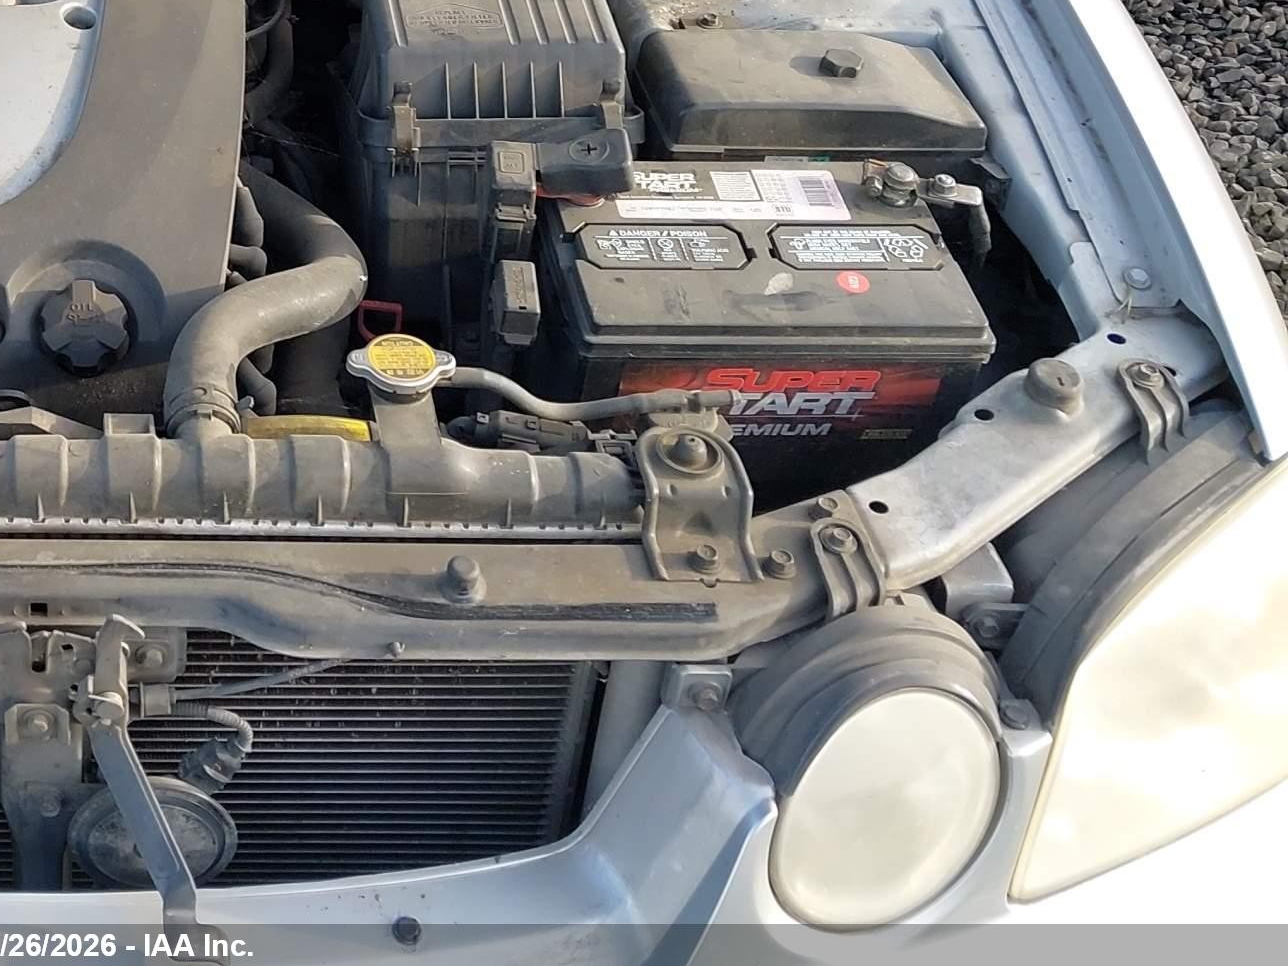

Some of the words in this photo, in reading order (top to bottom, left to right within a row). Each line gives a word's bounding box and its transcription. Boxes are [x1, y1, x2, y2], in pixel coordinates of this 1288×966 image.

[634, 180, 697, 189] TART
[670, 230, 707, 238] POISON
[70, 302, 94, 312] OIL
[706, 368, 881, 392] SUPER
[728, 392, 876, 416] TART
[731, 423, 833, 437] EMIUM
